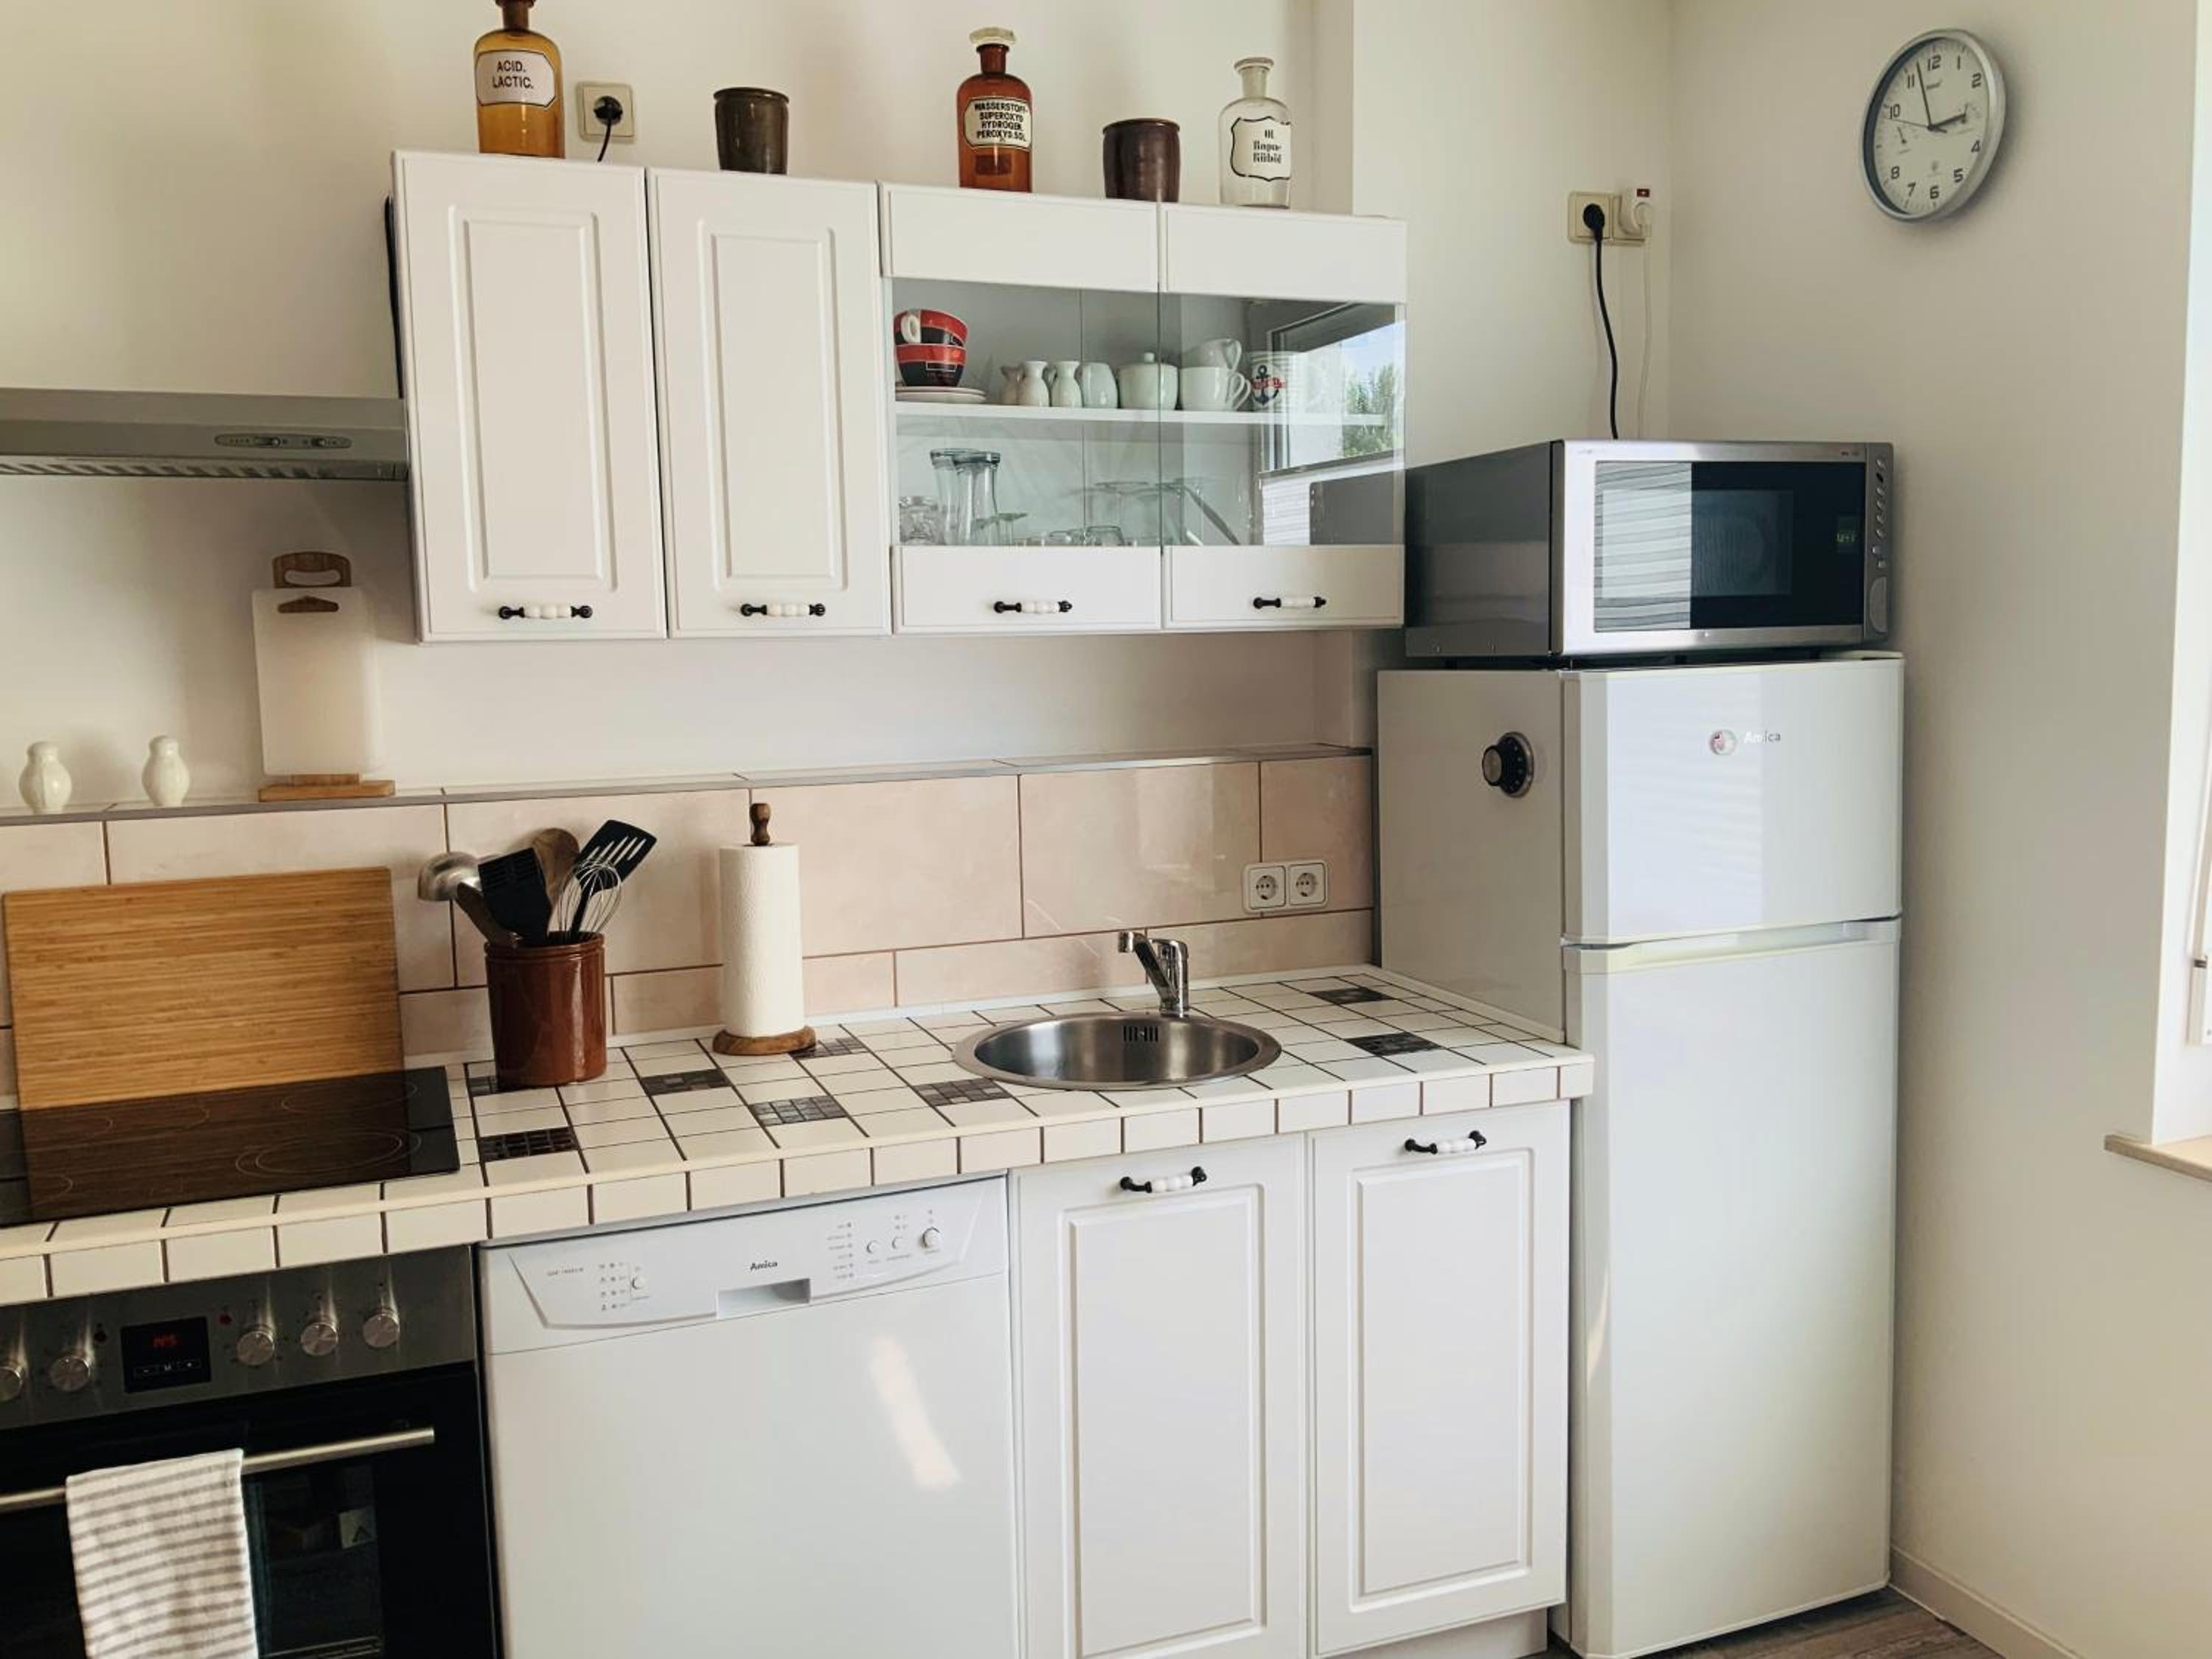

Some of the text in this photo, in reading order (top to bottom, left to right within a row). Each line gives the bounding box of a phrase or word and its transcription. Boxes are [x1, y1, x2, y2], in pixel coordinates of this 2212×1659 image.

[496, 60, 526, 72] ACID.
[1927, 55, 1942, 71] 12
[1956, 55, 1961, 70] 1
[492, 76, 534, 88] LACTIC.
[1907, 75, 1916, 89] 11
[1971, 73, 1982, 88] 2
[1890, 104, 1900, 119] 10
[1971, 140, 1980, 153] 4
[1891, 166, 1900, 179] 8
[1953, 168, 1963, 182] 5
[1907, 182, 1916, 197] 7
[1930, 186, 1939, 199] 6
[750, 1259, 778, 1271] Amica
